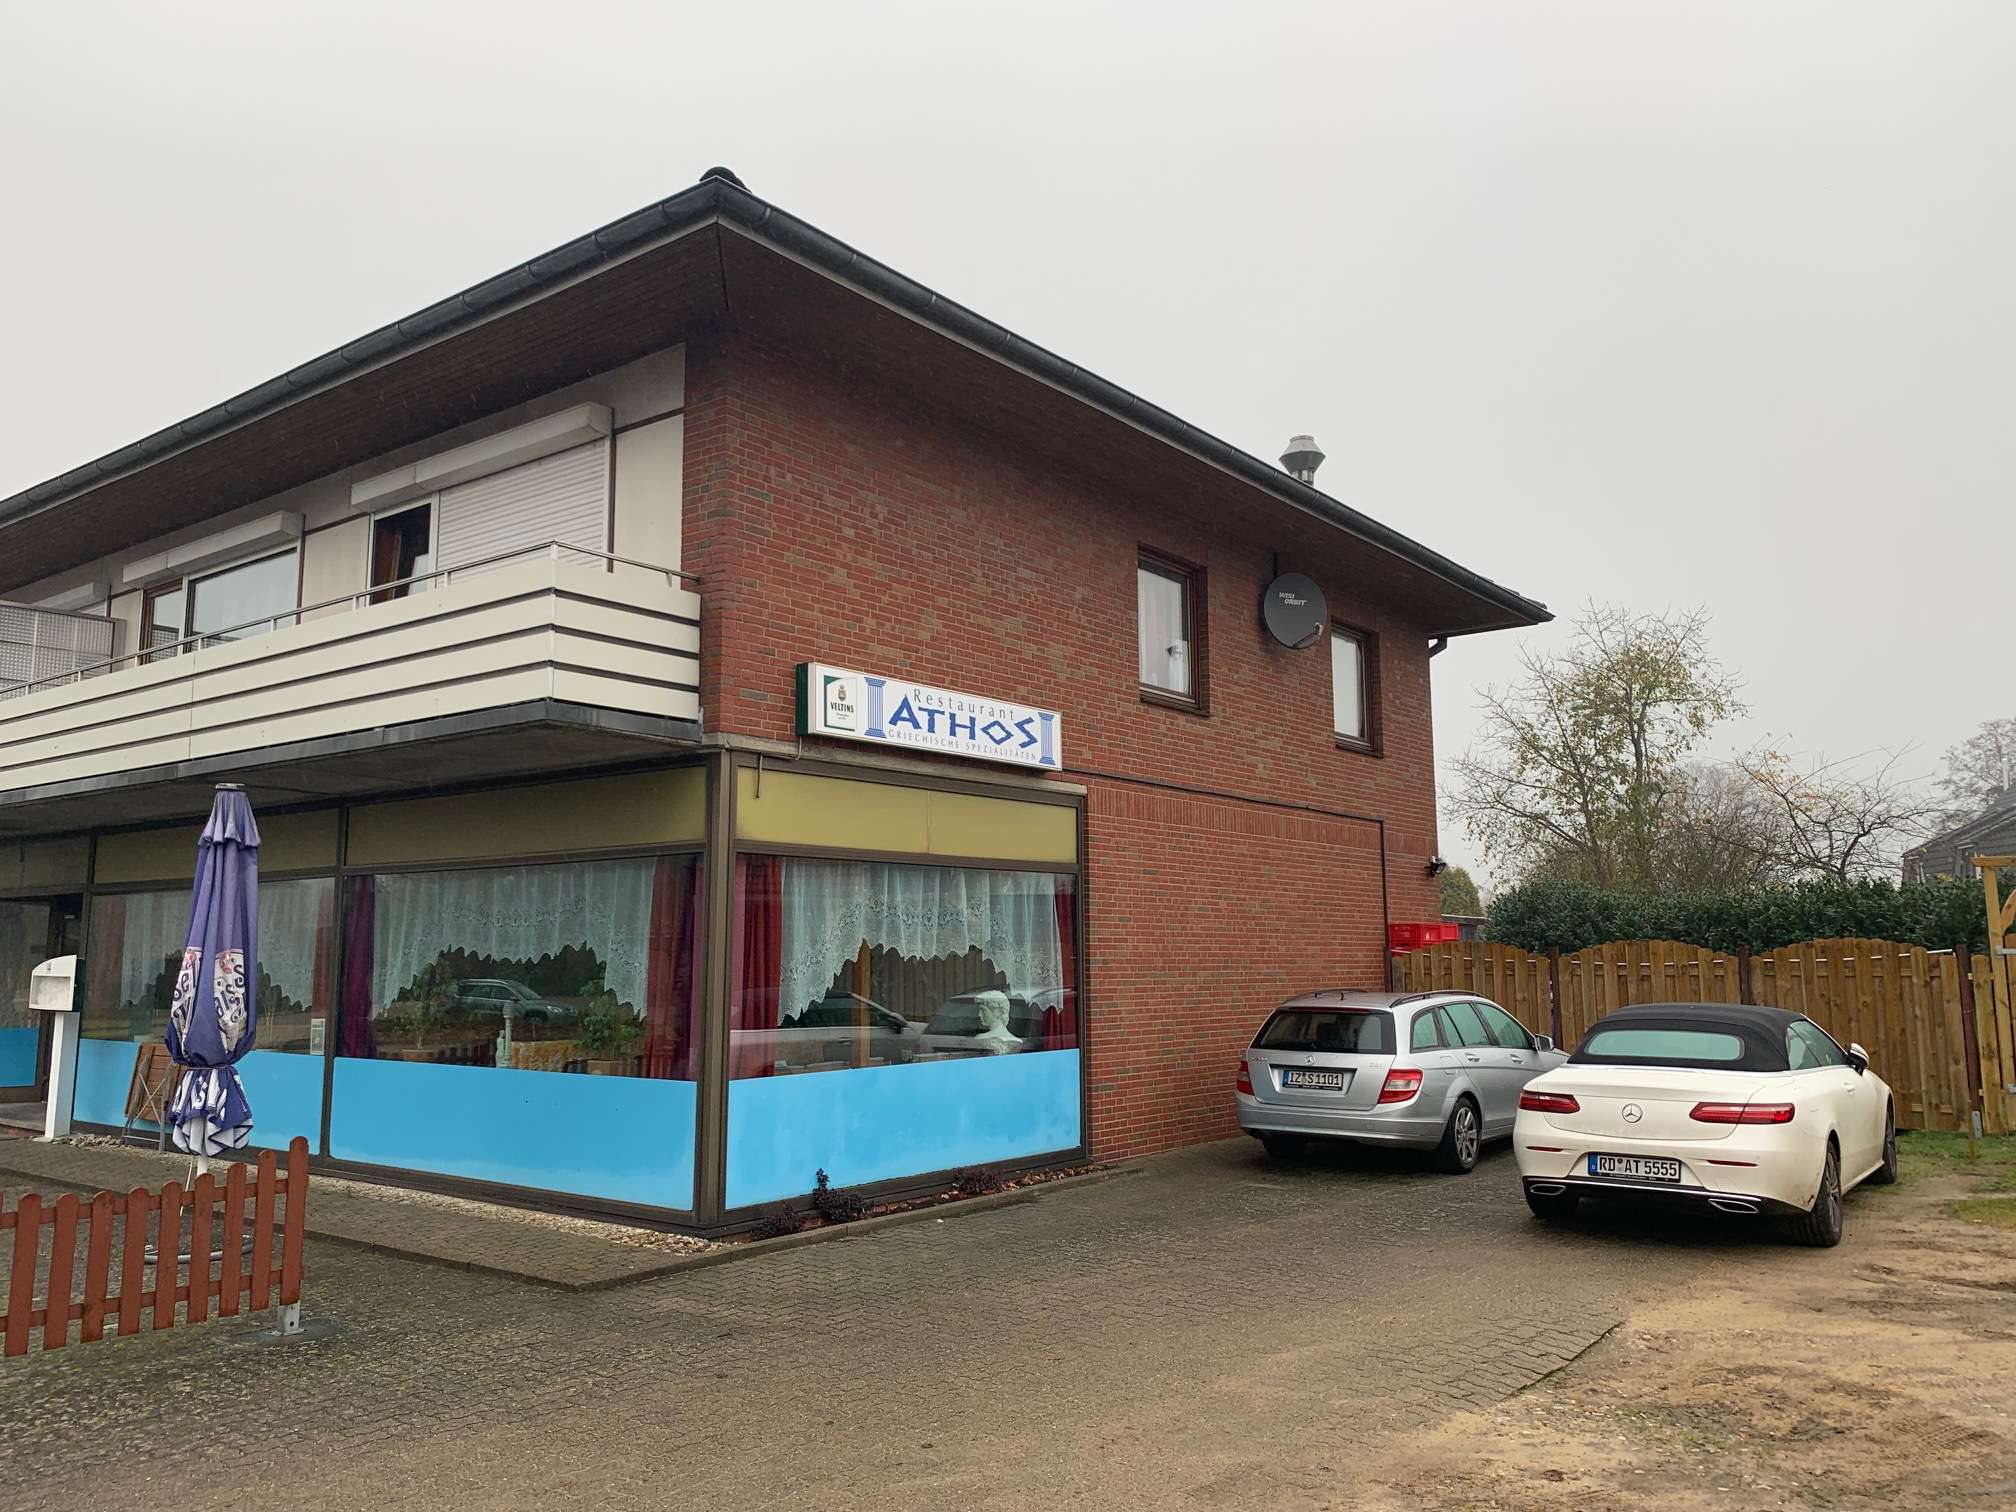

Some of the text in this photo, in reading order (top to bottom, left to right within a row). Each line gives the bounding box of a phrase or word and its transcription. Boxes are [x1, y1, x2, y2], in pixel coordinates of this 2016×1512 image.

[830, 701, 854, 713] VELTINS
[914, 688, 1016, 721] Restaurant
[888, 693, 1038, 749] ATHOS
[888, 729, 960, 749] GRIECHISCHE
[1289, 1072, 1302, 1084] IZ
[1599, 1157, 1616, 1172] RD
[1624, 1159, 1641, 1174] AT
[1644, 1160, 1677, 1177] 5555
